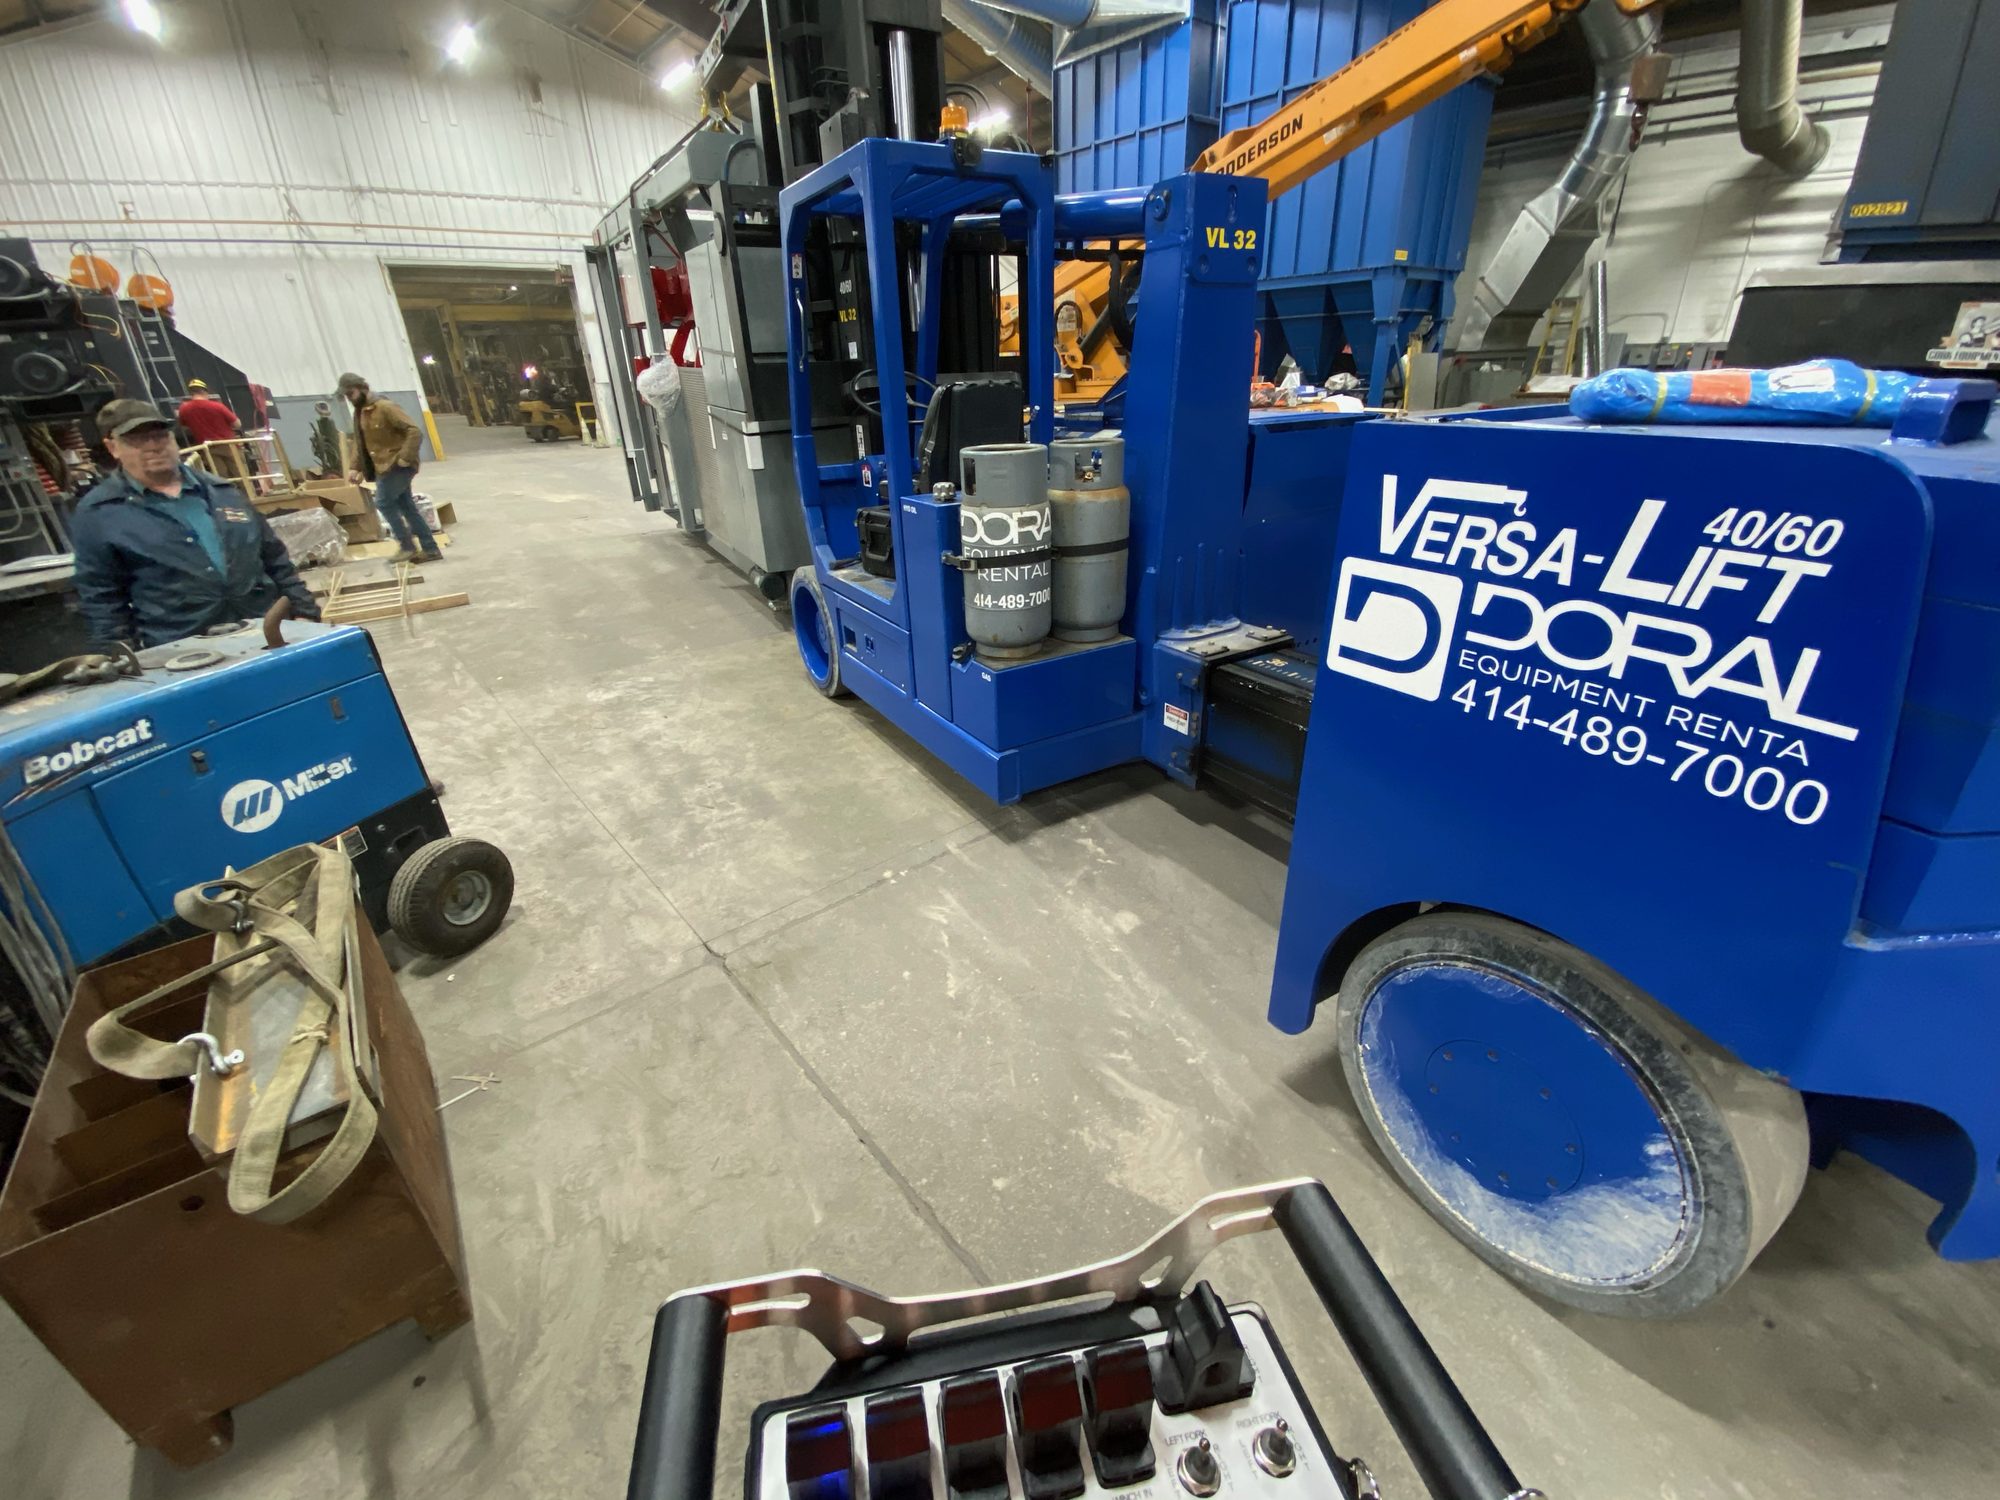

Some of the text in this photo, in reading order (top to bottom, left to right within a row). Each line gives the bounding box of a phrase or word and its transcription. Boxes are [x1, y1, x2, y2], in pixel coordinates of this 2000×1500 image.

[1215, 113, 1303, 175] ODERSON
[1206, 227, 1257, 250] VL 32
[839, 308, 857, 323] VL 32
[1703, 508, 1844, 557] 40/60
[977, 562, 1049, 582] RENTAL
[1465, 581, 1860, 742] DORAL
[1457, 649, 1810, 767] EQUIPMENT RENTA
[23, 718, 153, 785] Bobcat
[1452, 679, 1830, 826] 414-489-7000
[1164, 1428, 1208, 1447] LEFT FORK
